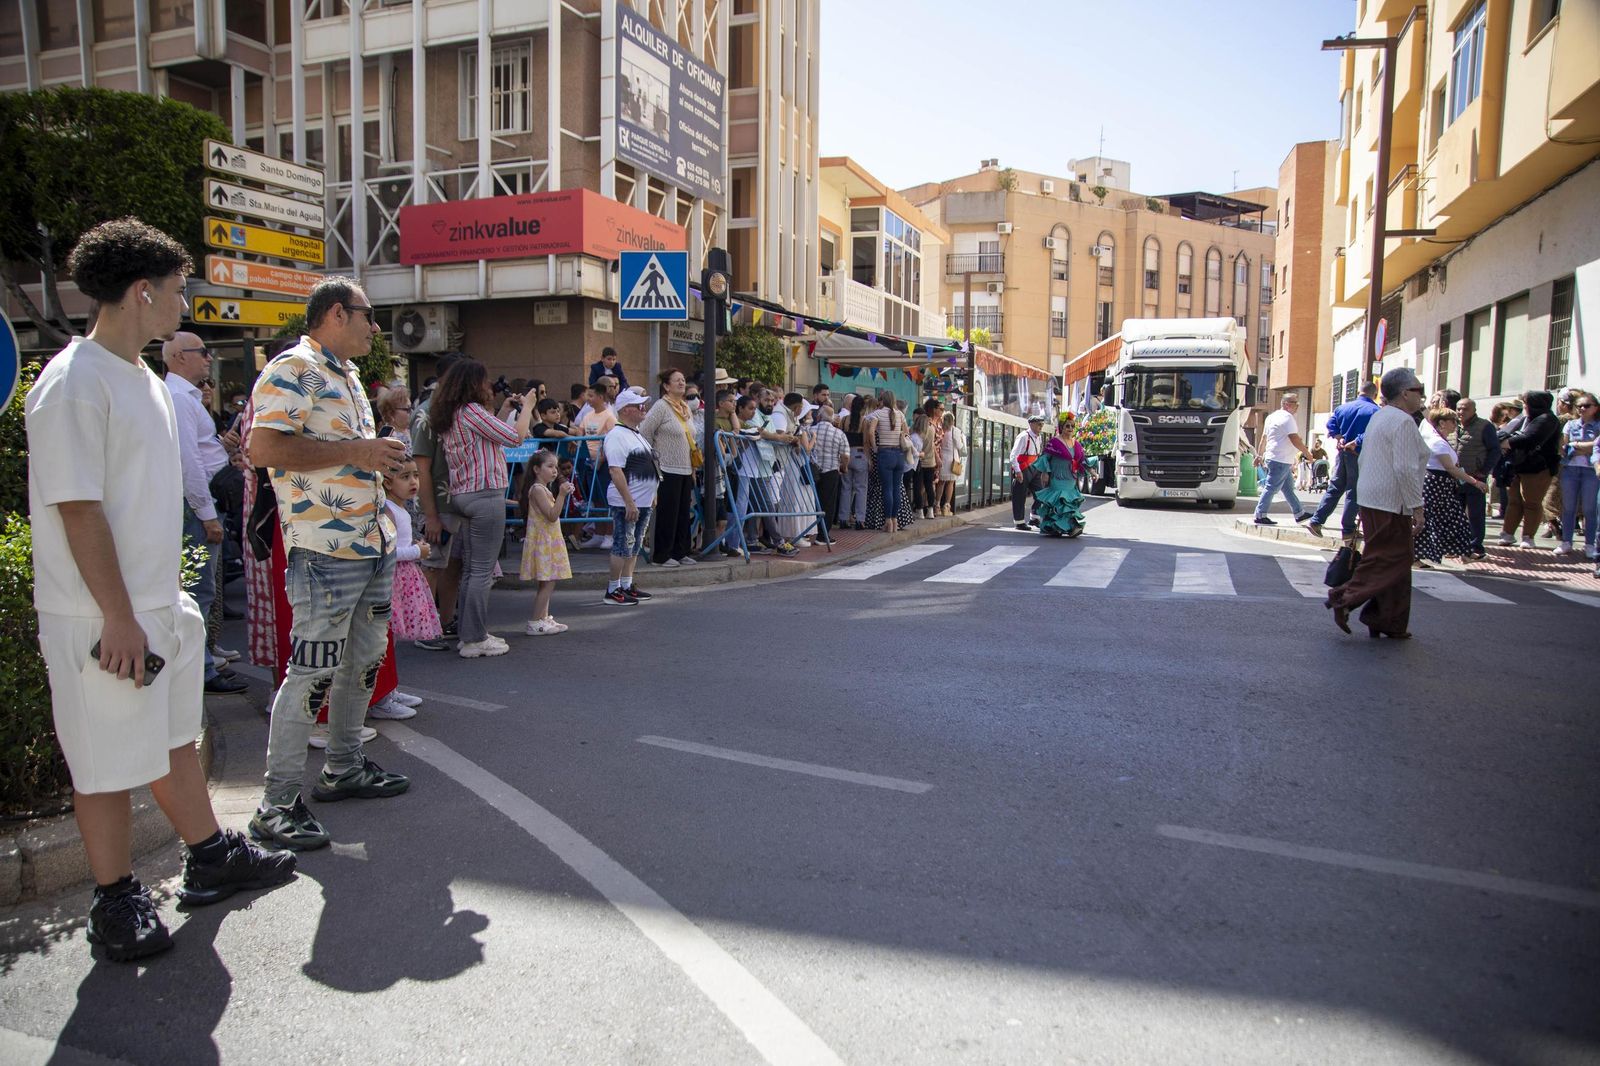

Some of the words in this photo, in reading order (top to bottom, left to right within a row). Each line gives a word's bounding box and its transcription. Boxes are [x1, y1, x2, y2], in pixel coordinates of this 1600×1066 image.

[621, 14, 669, 61] ALQUILER
[672, 48, 684, 71] DE
[687, 61, 721, 97] OFICINAS
[679, 82, 694, 99] Ahora
[694, 92, 707, 108] desde
[684, 100, 694, 113] mes
[694, 107, 704, 119] con
[631, 131, 649, 147] PARQUE
[679, 120, 695, 137] Oficina
[695, 131, 703, 141] del
[712, 142, 720, 152] con
[260, 162, 284, 177] Santo
[286, 169, 321, 188] Domingo
[287, 206, 298, 217] del
[449, 216, 541, 242] zinkvalue
[289, 235, 321, 250] hospital
[616, 224, 666, 251] zinkvalue
[282, 246, 321, 259] urgencias
[459, 247, 495, 257] FINANCIERO
[270, 270, 293, 281] campo
[293, 273, 303, 281] de
[672, 329, 693, 340] PARQUE
[1158, 415, 1201, 424] SCANIA
[1123, 433, 1133, 442] 28
